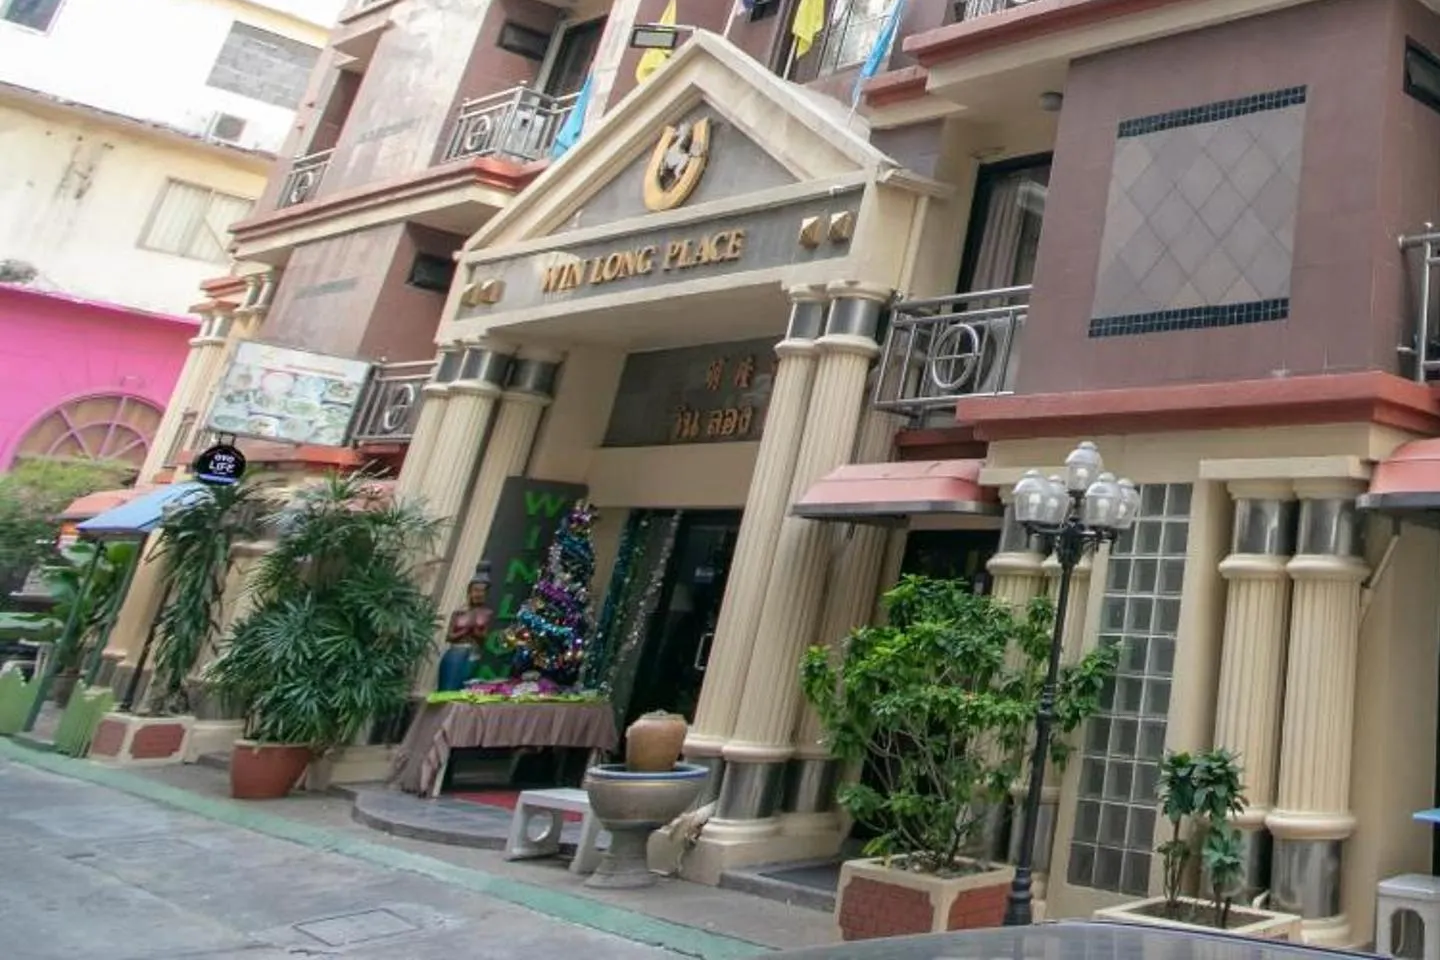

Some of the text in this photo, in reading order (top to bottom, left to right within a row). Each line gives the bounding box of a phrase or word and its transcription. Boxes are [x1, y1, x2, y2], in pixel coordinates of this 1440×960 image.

[541, 229, 744, 293] WIN LONG PLACE
